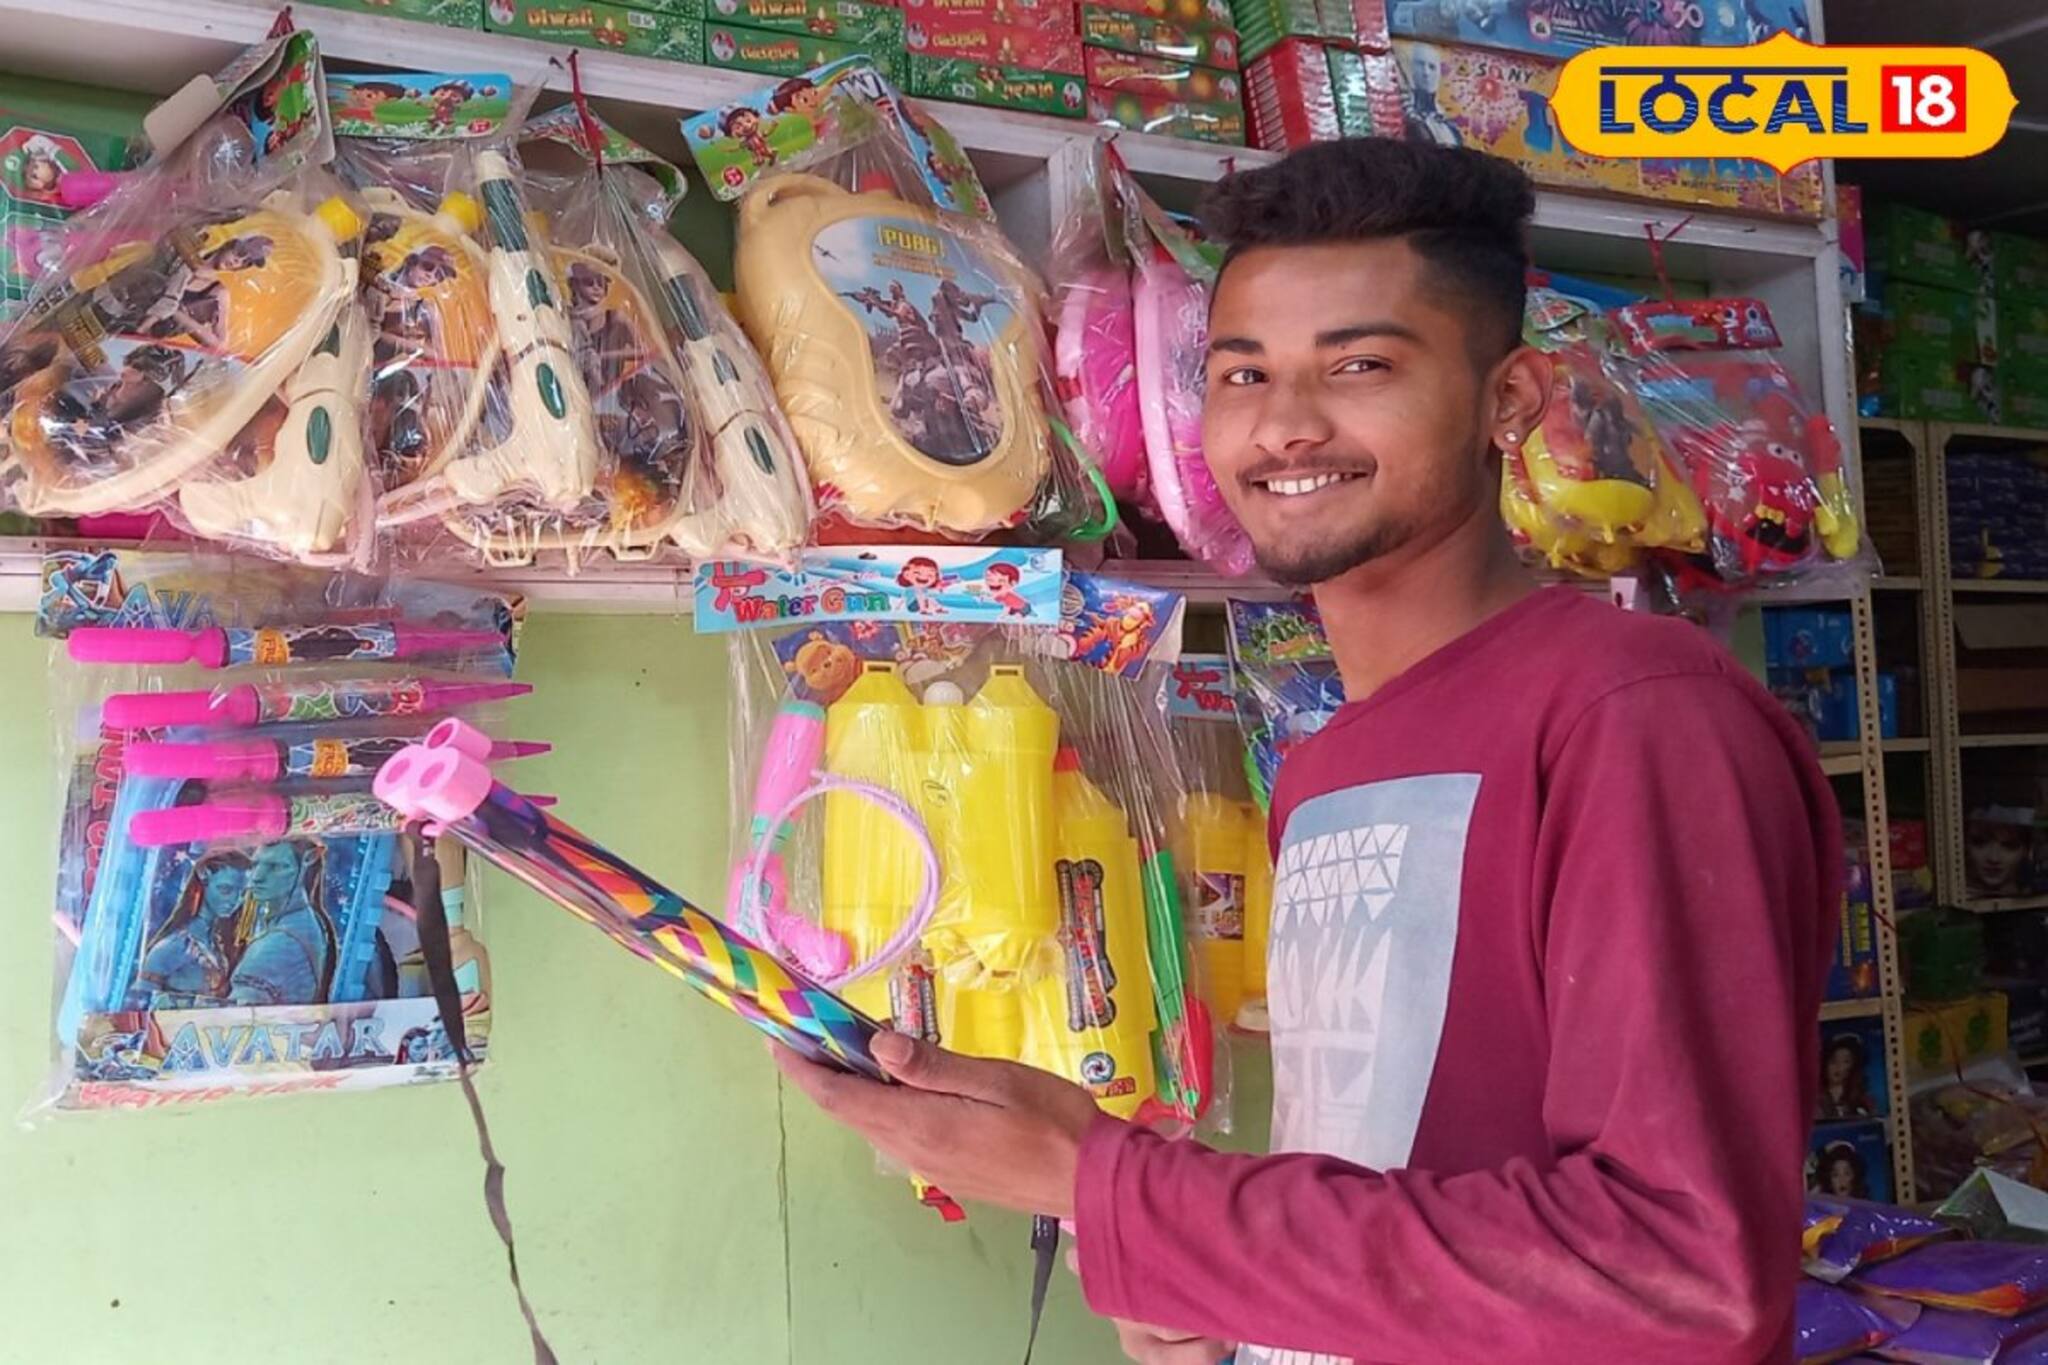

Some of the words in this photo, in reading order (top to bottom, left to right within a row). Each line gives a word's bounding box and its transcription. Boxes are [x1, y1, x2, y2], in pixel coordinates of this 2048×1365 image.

[525, 8, 595, 28] Diwali
[883, 226, 939, 254] PUBG
[732, 594, 819, 623] Water
[820, 586, 892, 615] Gun
[162, 1018, 389, 1073] AVATAR
